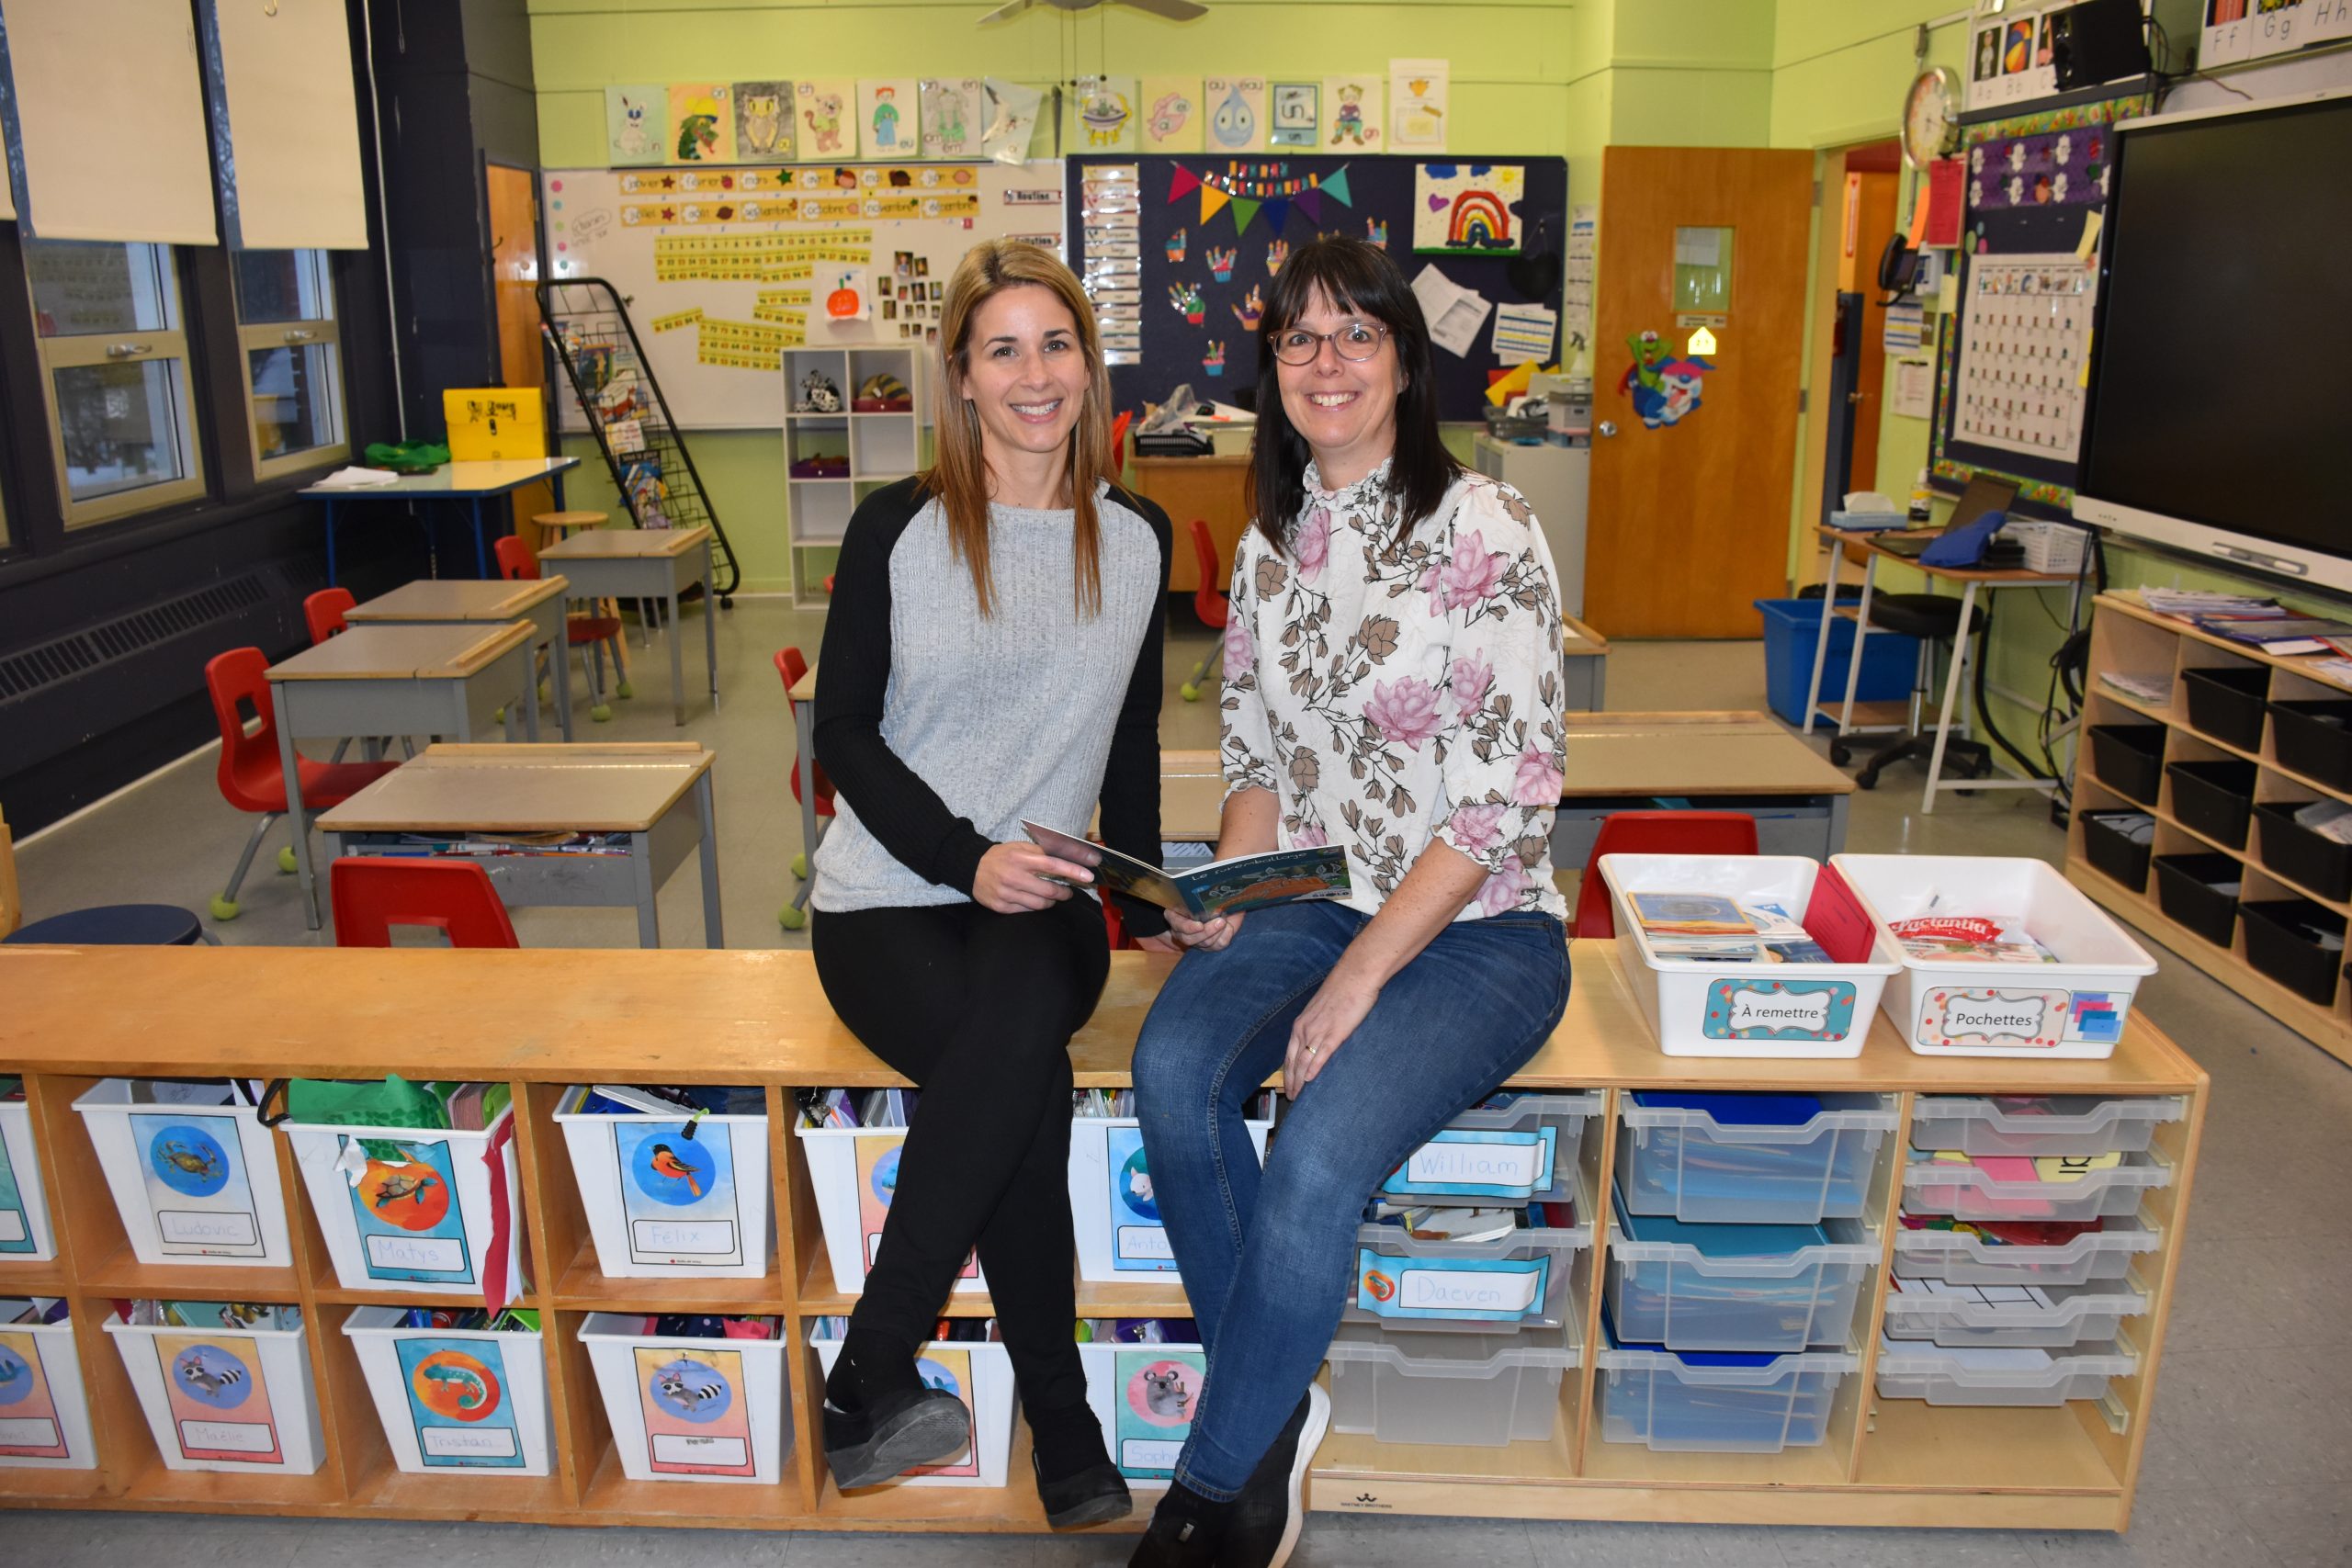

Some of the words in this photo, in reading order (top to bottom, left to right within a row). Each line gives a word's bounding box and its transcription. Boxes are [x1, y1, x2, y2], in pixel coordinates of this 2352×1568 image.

[1215, 852, 1307, 874] suremballage
[1892, 917, 1988, 935] Lactantia
[1741, 1004, 1753, 1019] À
[1755, 1007, 1818, 1020] remettre
[1955, 1012, 2032, 1027] Pochettes
[1419, 1148, 1519, 1176] William
[171, 1216, 241, 1237] Ludovic
[650, 1224, 701, 1245] Félix
[377, 1239, 439, 1264] Matys
[1126, 1235, 1168, 1250] Anto
[1418, 1275, 1501, 1303] Daeven
[428, 1434, 493, 1449] Tristan
[1131, 1444, 1177, 1464] Sophi
